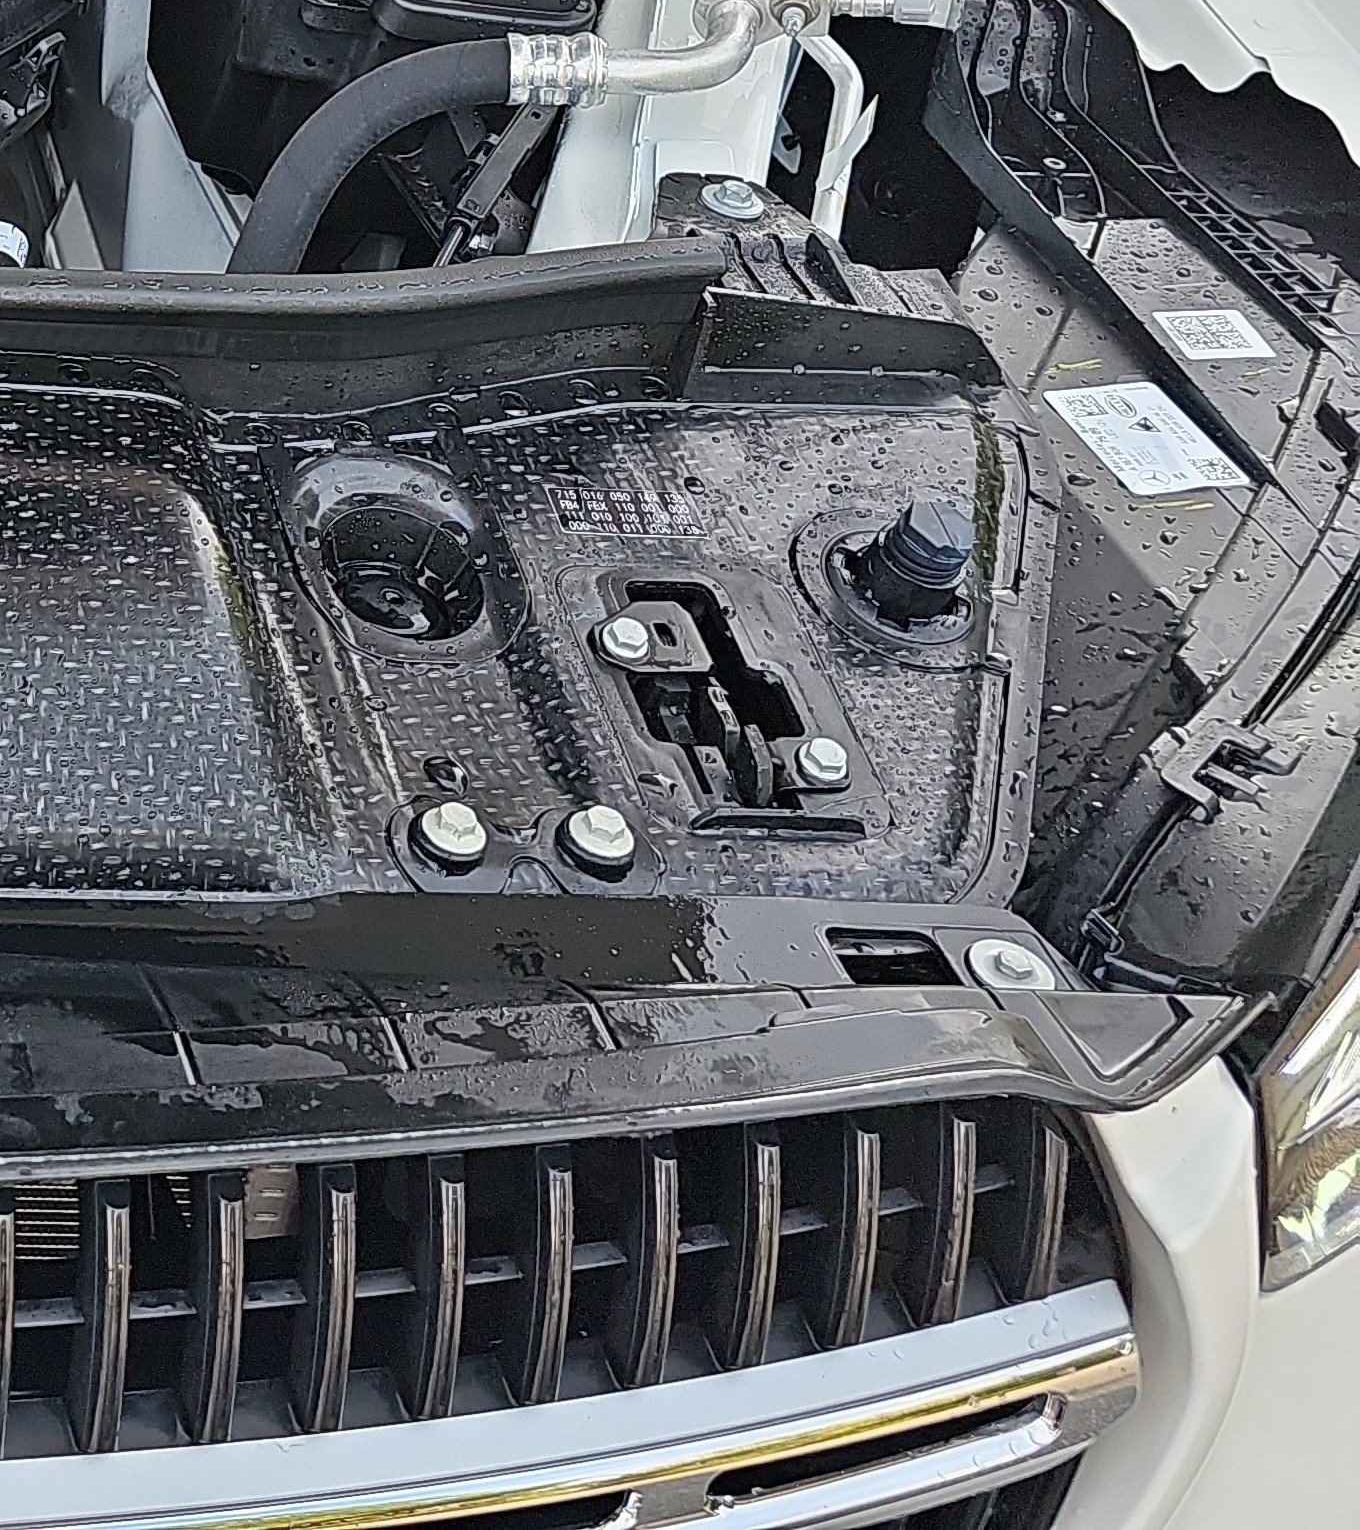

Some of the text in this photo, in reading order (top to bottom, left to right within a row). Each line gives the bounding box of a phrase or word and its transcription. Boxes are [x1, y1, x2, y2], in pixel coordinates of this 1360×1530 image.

[555, 490, 577, 499] 715
[615, 503, 634, 512] 110
[641, 503, 662, 513] 001
[668, 504, 689, 514] 000
[591, 512, 612, 521] 010
[620, 513, 639, 523] 100
[673, 515, 693, 524] 001
[569, 521, 590, 530] 000
[623, 524, 643, 533] 011
